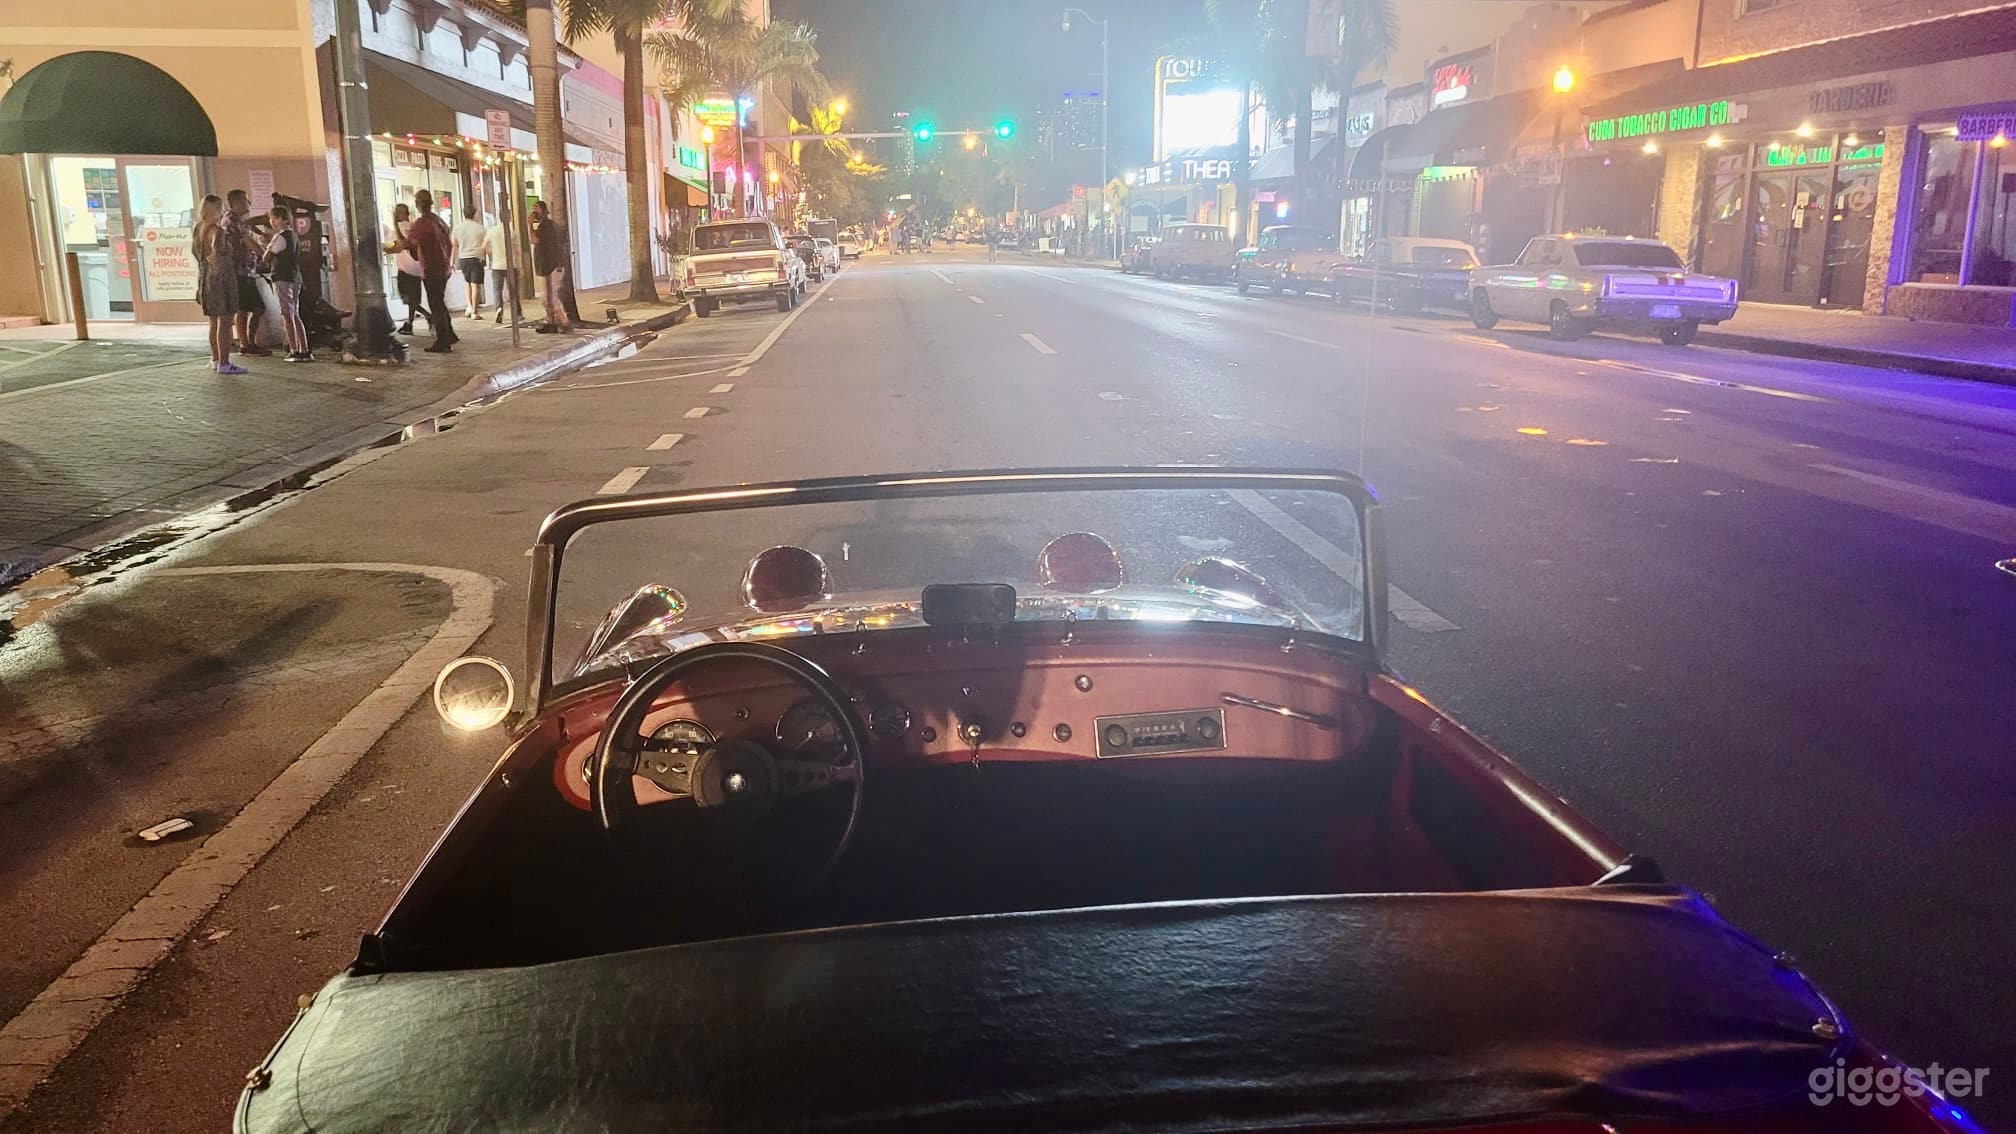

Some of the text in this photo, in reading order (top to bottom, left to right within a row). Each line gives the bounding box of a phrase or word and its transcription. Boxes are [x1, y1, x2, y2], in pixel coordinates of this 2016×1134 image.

[1589, 119, 1615, 141] CUBA
[1618, 110, 1667, 138] TOBACCO
[1669, 104, 1707, 131] CIGAR
[411, 151, 426, 165] PASTA
[444, 157, 457, 169] PIZZA
[156, 247, 183, 256] NOW
[153, 258, 189, 268] HIRING
